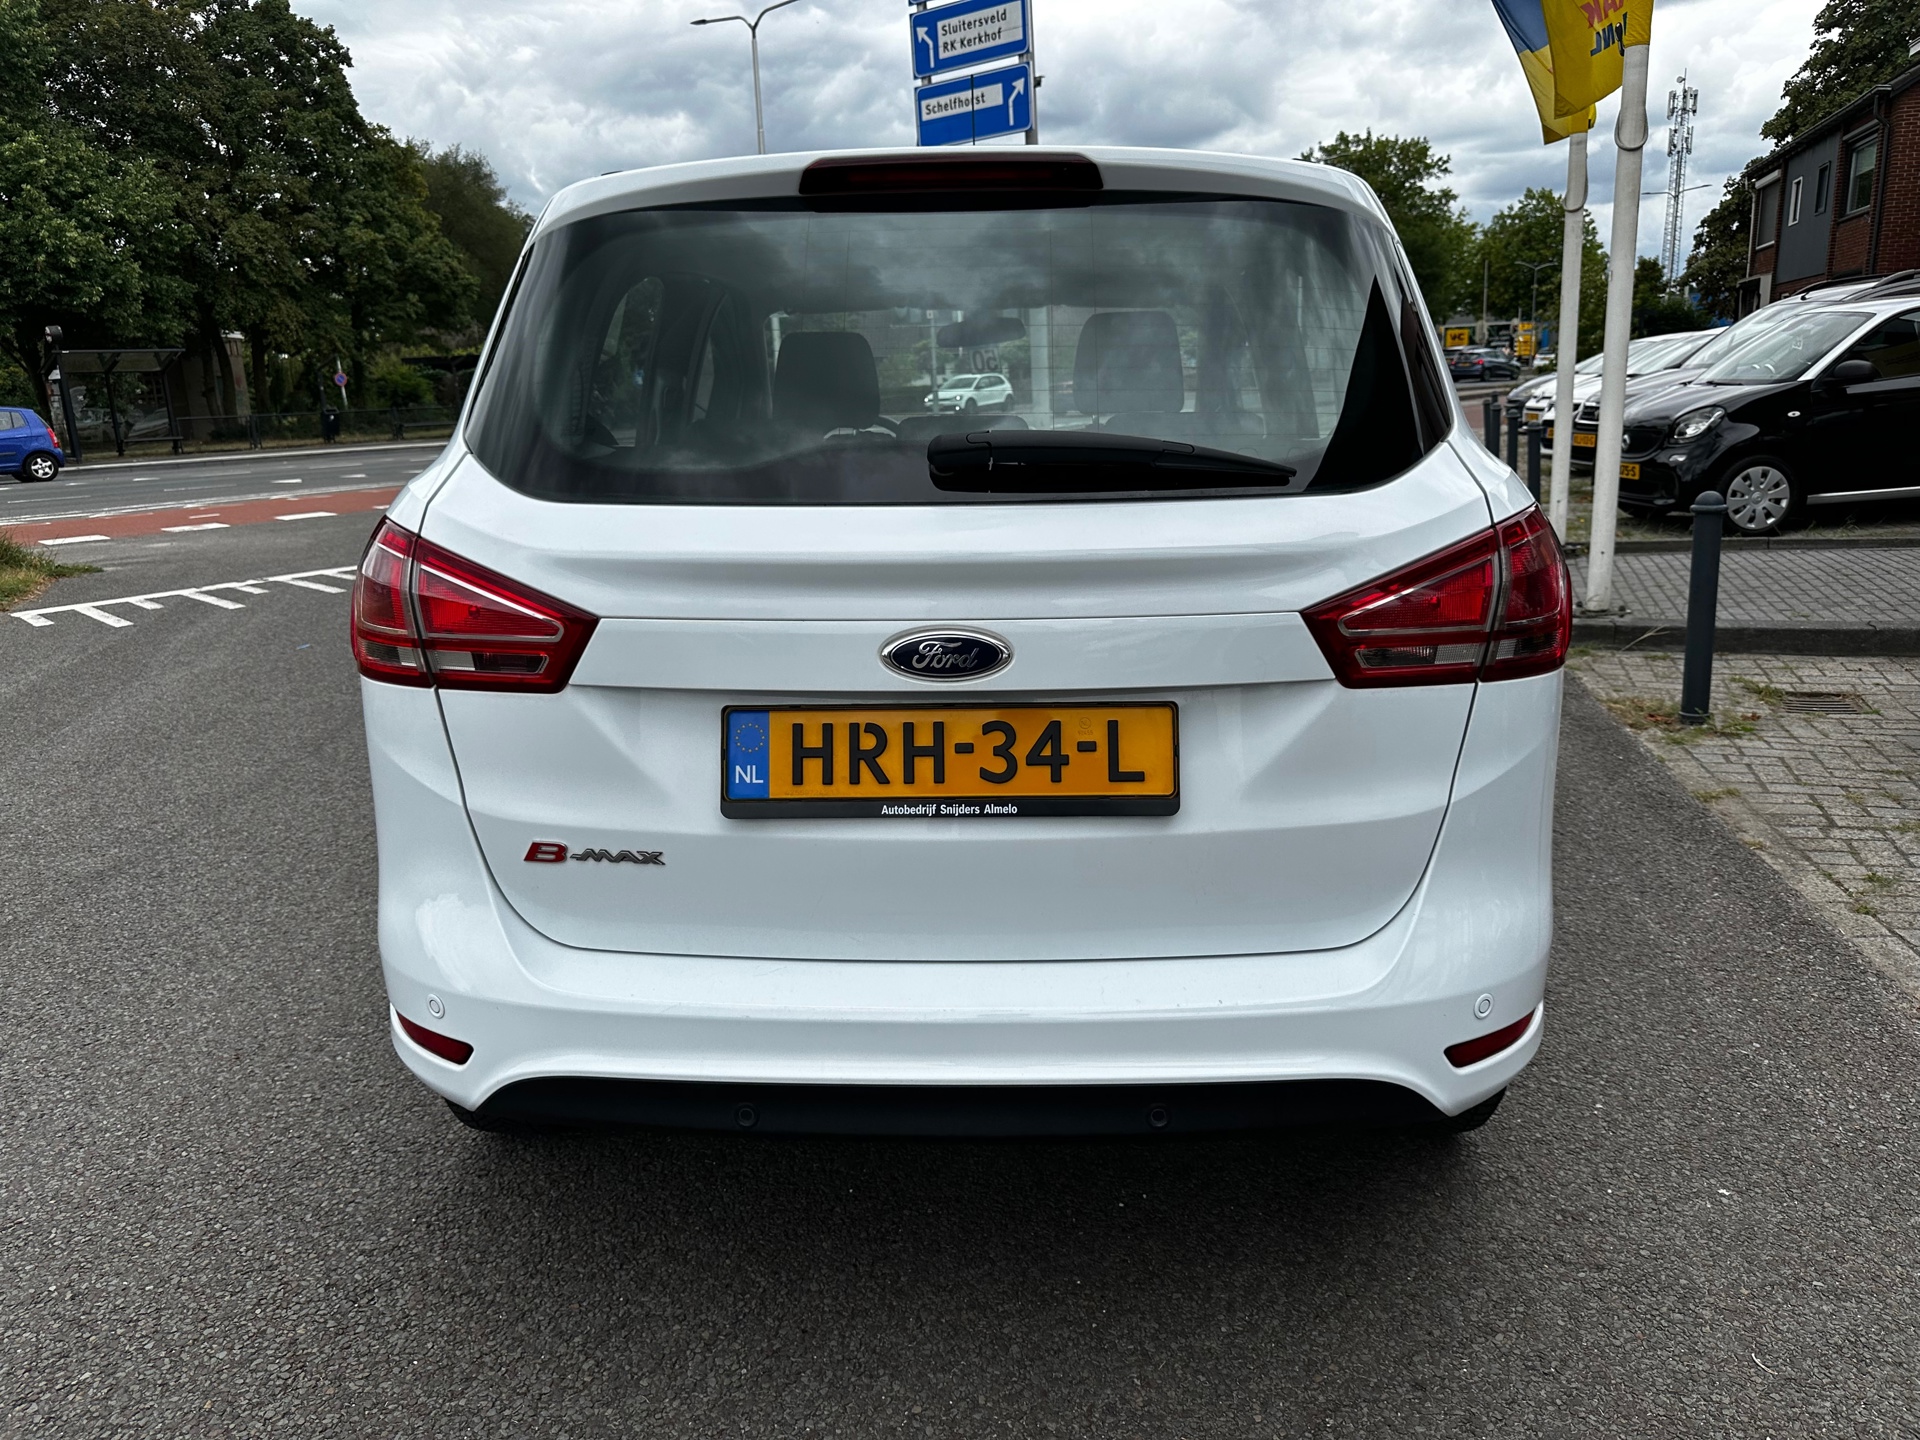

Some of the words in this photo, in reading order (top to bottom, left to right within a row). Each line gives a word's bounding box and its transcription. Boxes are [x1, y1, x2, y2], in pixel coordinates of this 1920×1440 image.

[941, 9, 1007, 37] Sluitersveld
[943, 40, 957, 53] RK
[960, 27, 1003, 49] Kerkhof
[912, 641, 979, 668] Ford
[791, 719, 1145, 785] HRH-34-L
[735, 765, 764, 784] NL
[881, 804, 937, 816] Autobedrijf
[940, 804, 980, 816] Snijders
[984, 804, 1018, 814] Almelo
[523, 840, 666, 866] B-MAX
